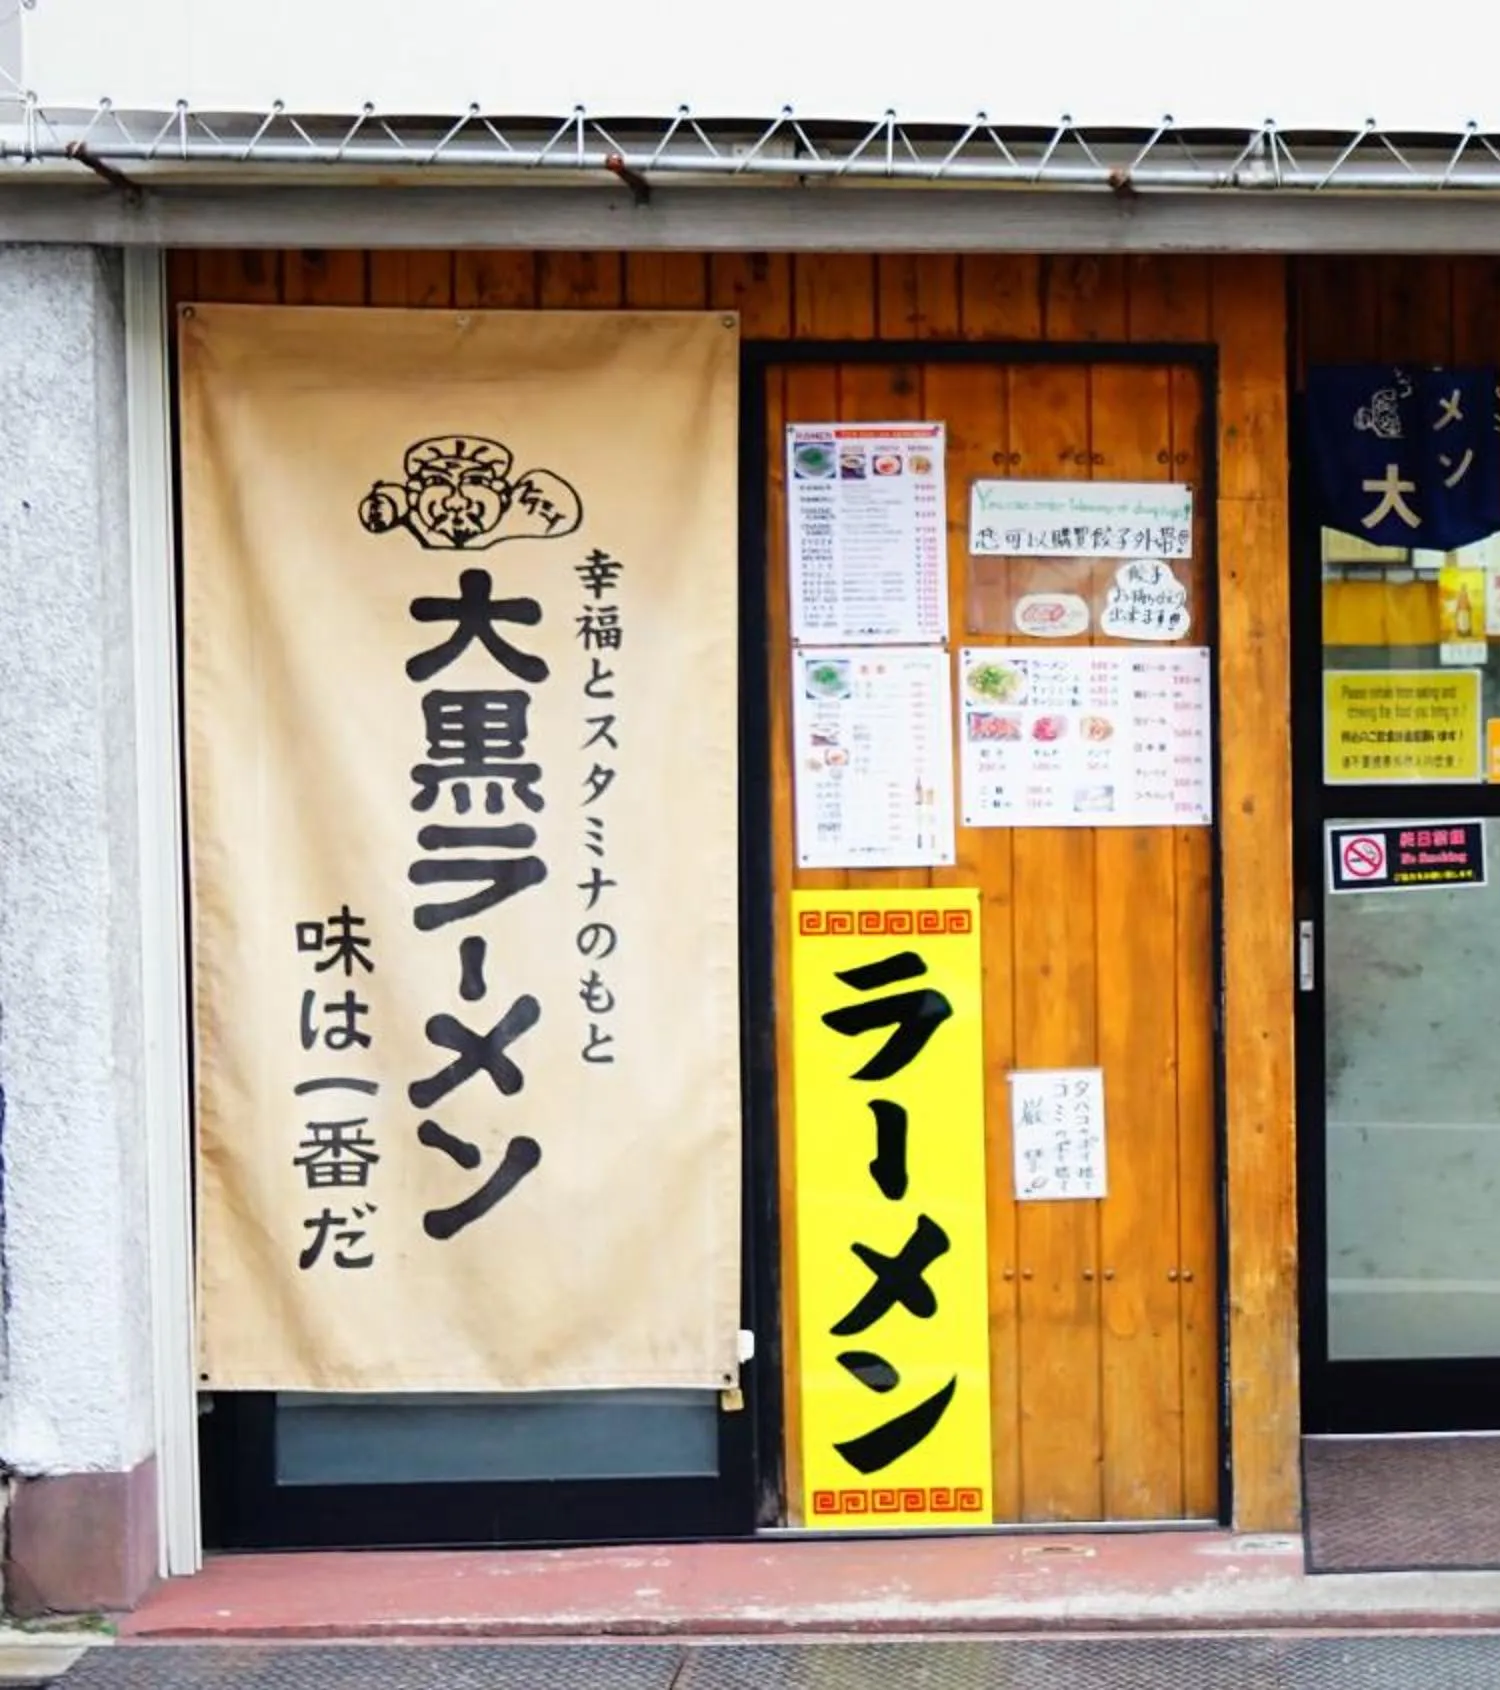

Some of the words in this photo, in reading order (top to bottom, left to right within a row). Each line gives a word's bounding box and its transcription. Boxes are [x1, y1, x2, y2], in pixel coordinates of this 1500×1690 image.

[1361, 463, 1422, 529] 大
[405, 567, 550, 1242] 大黒ラーメン
[572, 549, 624, 1067] 幸福とスタミナのもと
[292, 905, 380, 1270] 味は一番だ
[820, 951, 958, 1476] ラーメン
